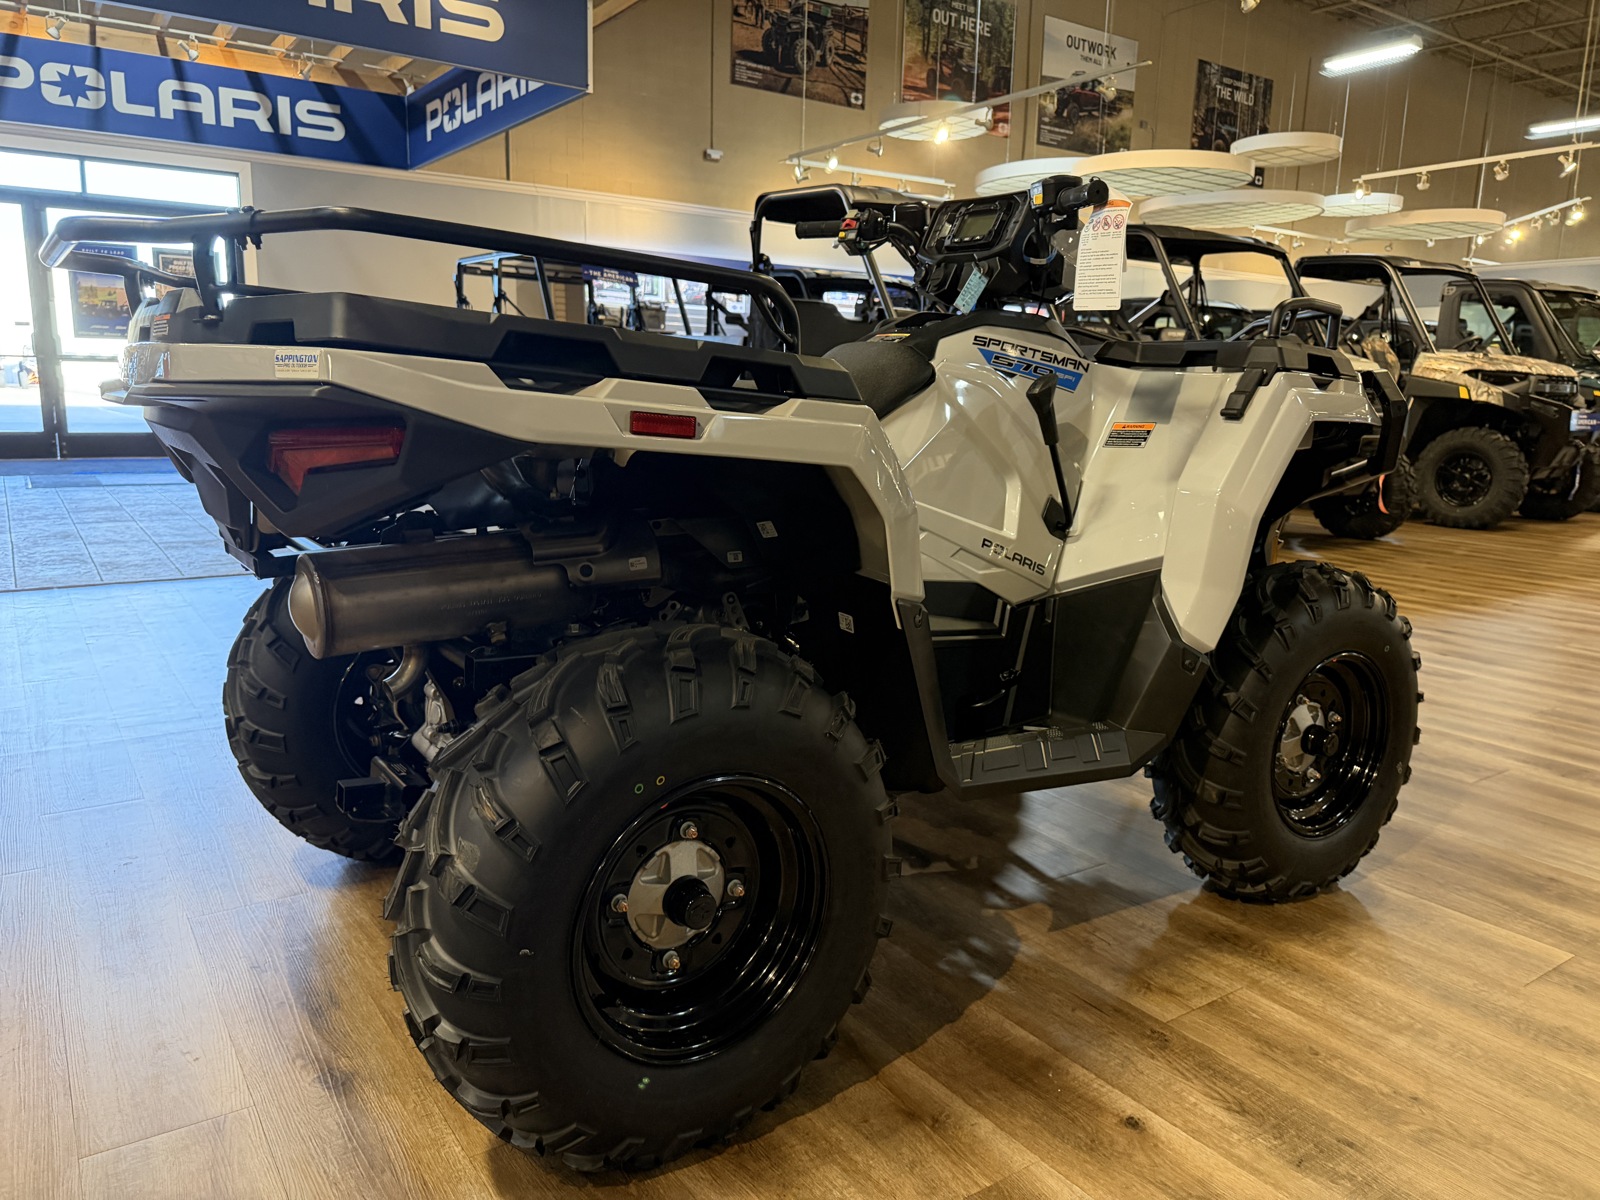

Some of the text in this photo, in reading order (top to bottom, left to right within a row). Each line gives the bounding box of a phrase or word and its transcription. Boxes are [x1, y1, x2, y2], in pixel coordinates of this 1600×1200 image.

[308, 0, 505, 42] RIS
[932, 7, 992, 37] OUT HERE
[1066, 34, 1117, 60] OUTWORK
[0, 56, 346, 142] POLARIS
[425, 71, 545, 143] POLAR
[1215, 84, 1255, 107] THE WILD
[275, 354, 319, 363] SAPPINGTON
[972, 335, 1090, 373] SPORTSMAN
[990, 353, 1056, 377] 570
[980, 537, 1047, 576] POLARIS
